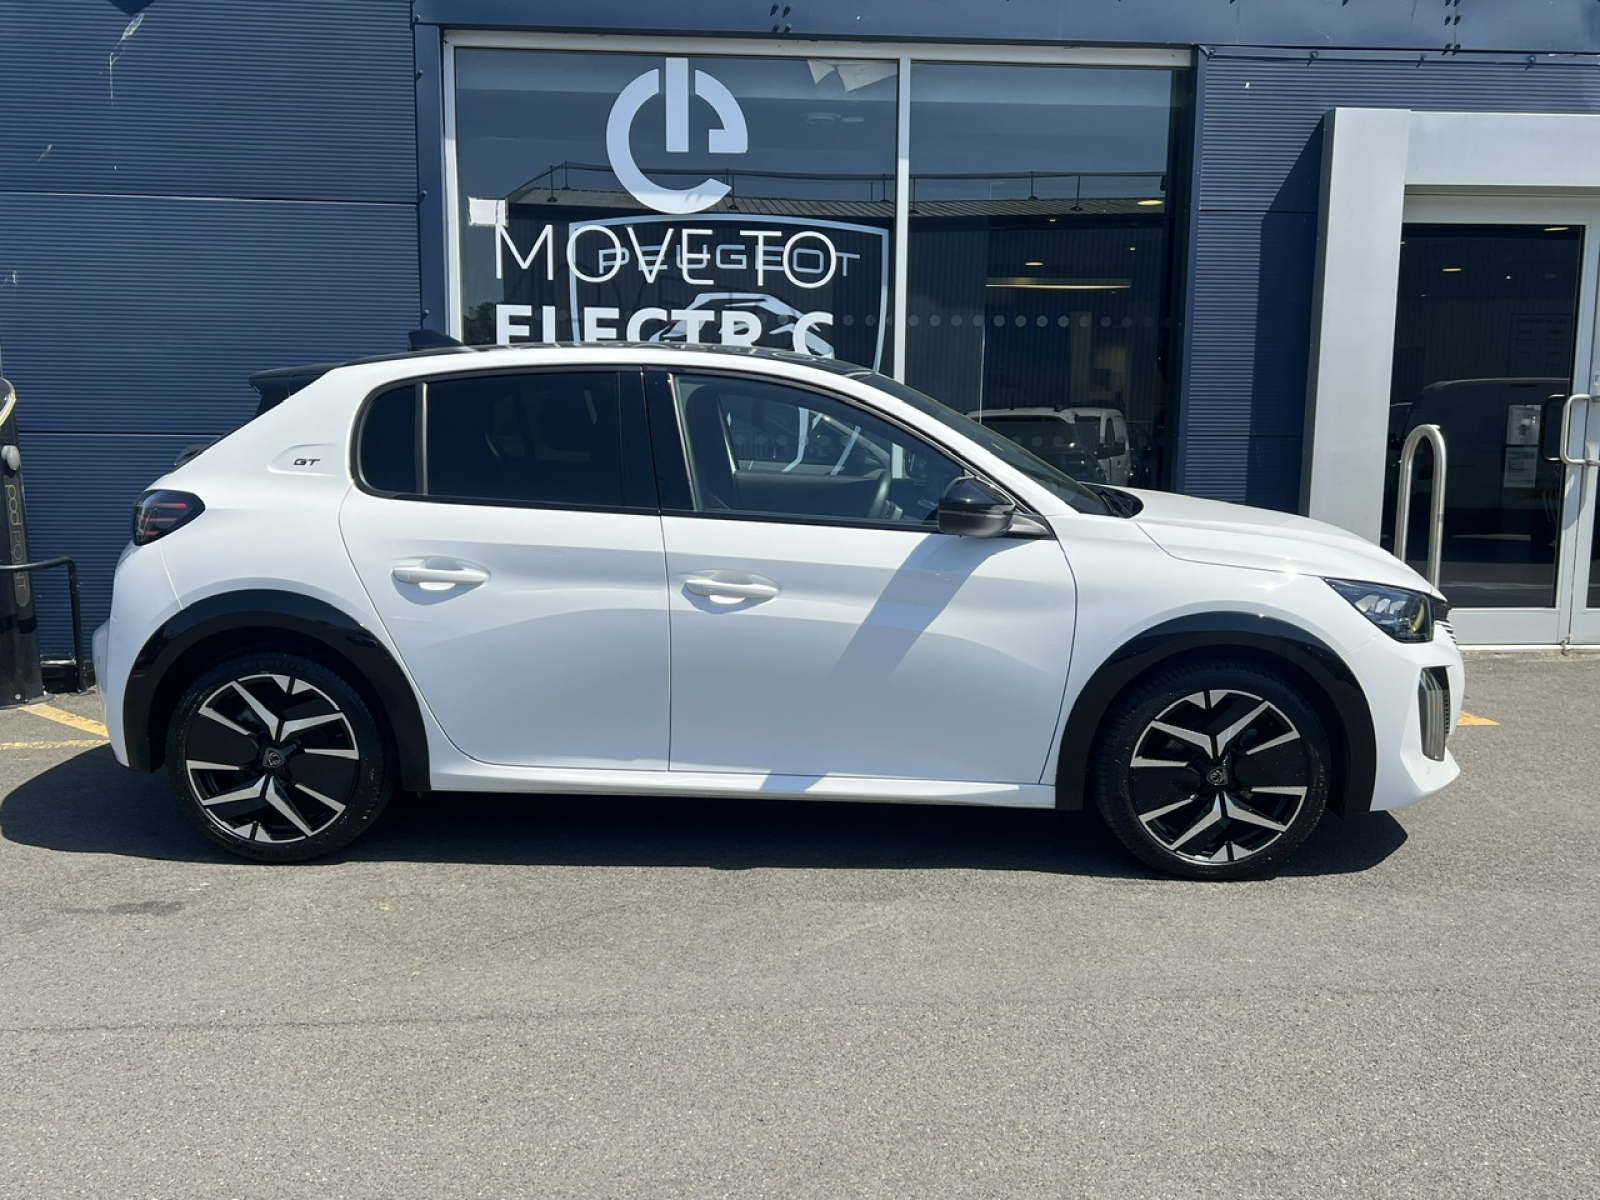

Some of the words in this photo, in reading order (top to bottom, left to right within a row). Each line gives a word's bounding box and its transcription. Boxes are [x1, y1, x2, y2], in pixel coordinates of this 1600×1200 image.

[495, 224, 714, 284] MOVE
[740, 229, 837, 289] TO
[599, 244, 861, 276] PEUGEOT
[293, 458, 321, 466] GT
